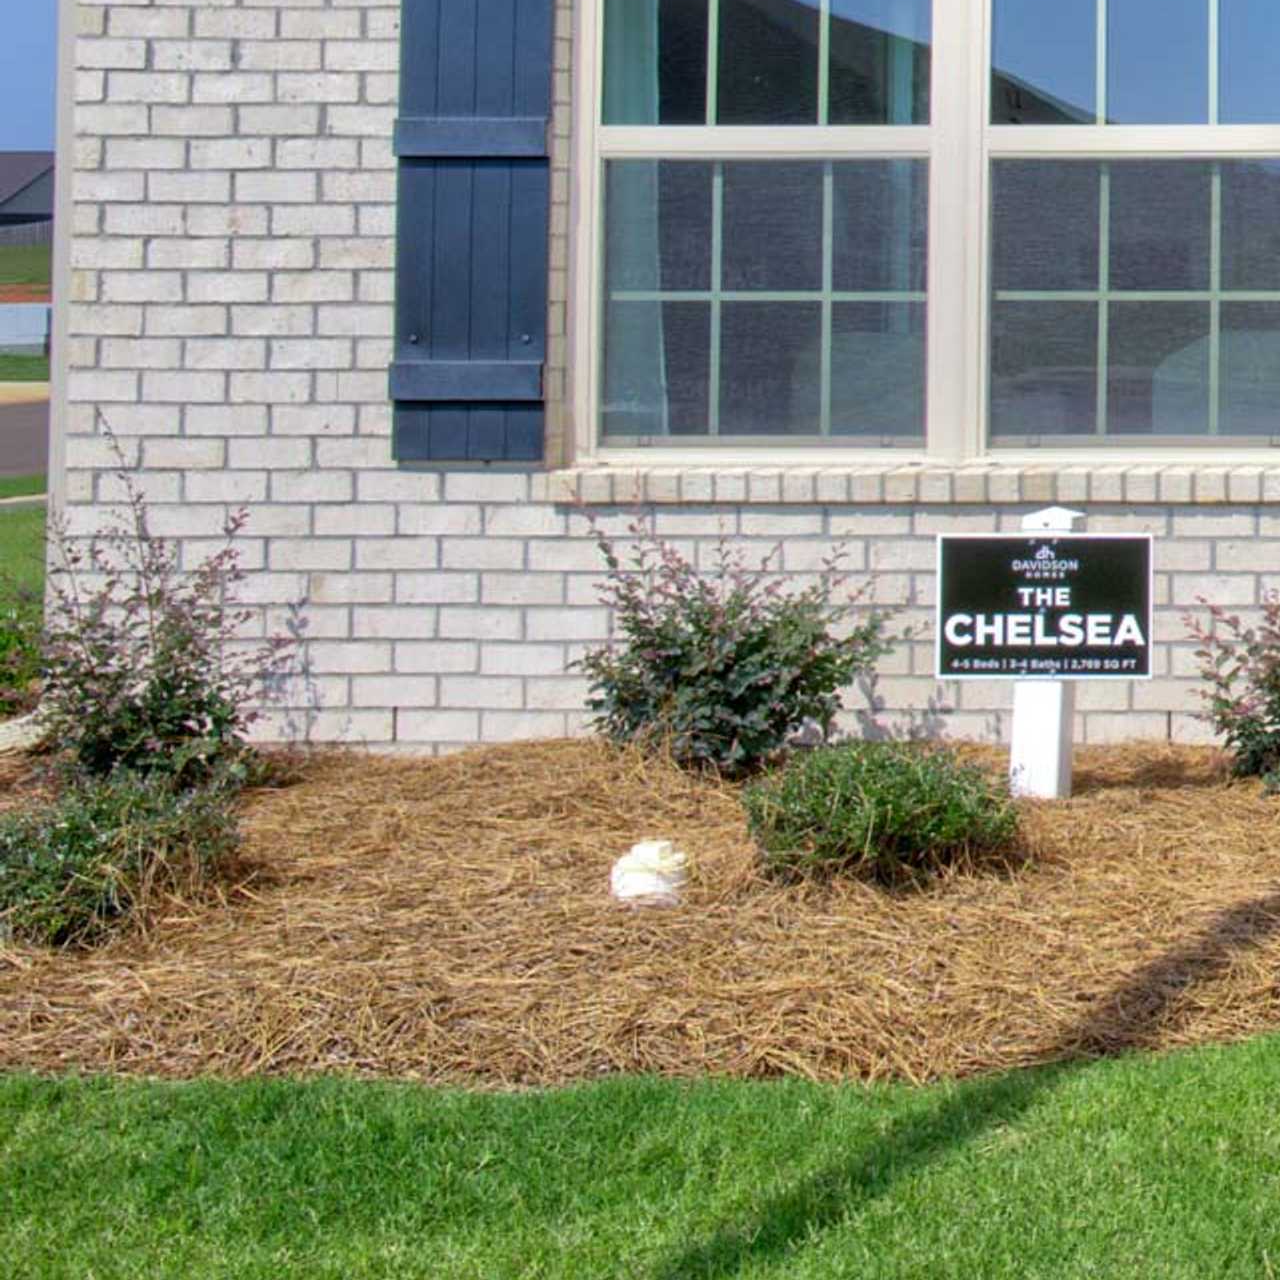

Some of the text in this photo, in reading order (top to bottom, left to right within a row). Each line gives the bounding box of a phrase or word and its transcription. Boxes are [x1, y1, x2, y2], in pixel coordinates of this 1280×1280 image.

[1011, 559, 1078, 570] DAVIDSON
[1018, 587, 1071, 607] THE
[944, 613, 1145, 646] CHELSEA
[973, 658, 1000, 669] Beds
[1031, 658, 1061, 669] Baths
[1122, 658, 1137, 669] FT
